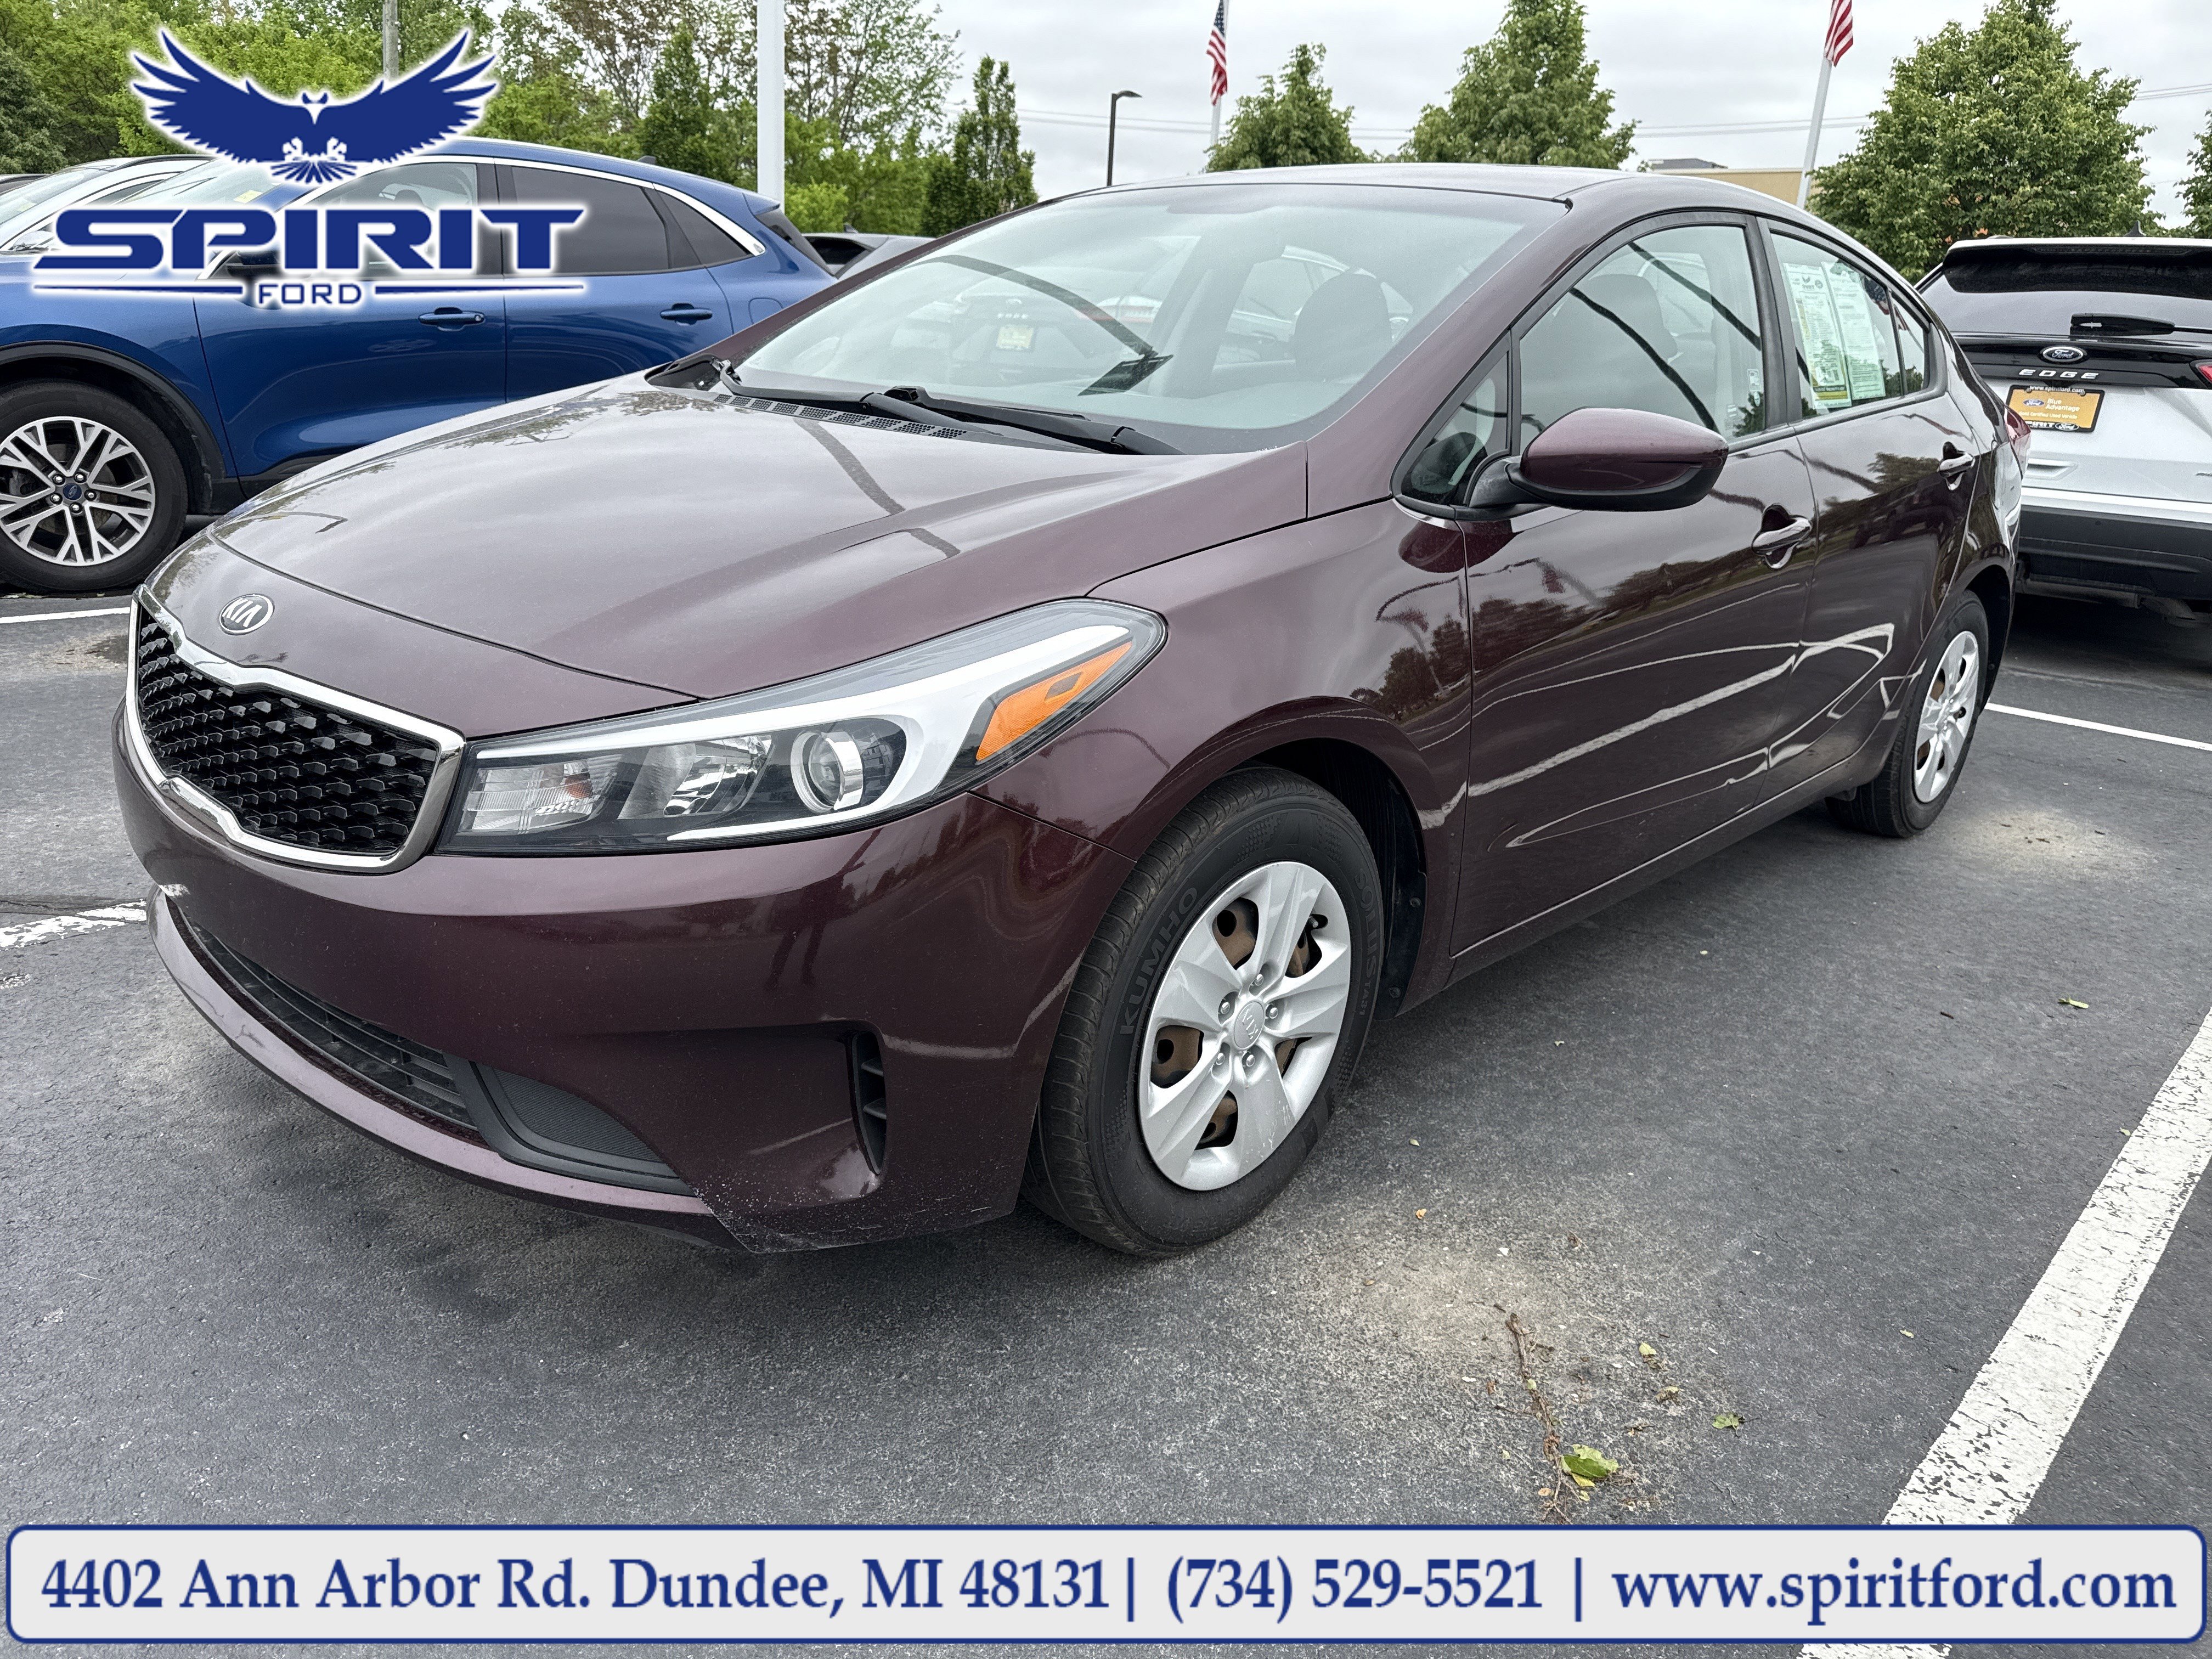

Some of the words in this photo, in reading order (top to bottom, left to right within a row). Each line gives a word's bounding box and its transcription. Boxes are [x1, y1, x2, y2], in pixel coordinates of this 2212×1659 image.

[2051, 349, 2074, 358] Ford
[2019, 369, 2099, 379] EDGE
[2045, 404, 2080, 413] Advantage
[222, 597, 262, 628] KIA
[1355, 868, 1378, 979] SOLUS
[1120, 887, 1198, 1035] KUMHO
